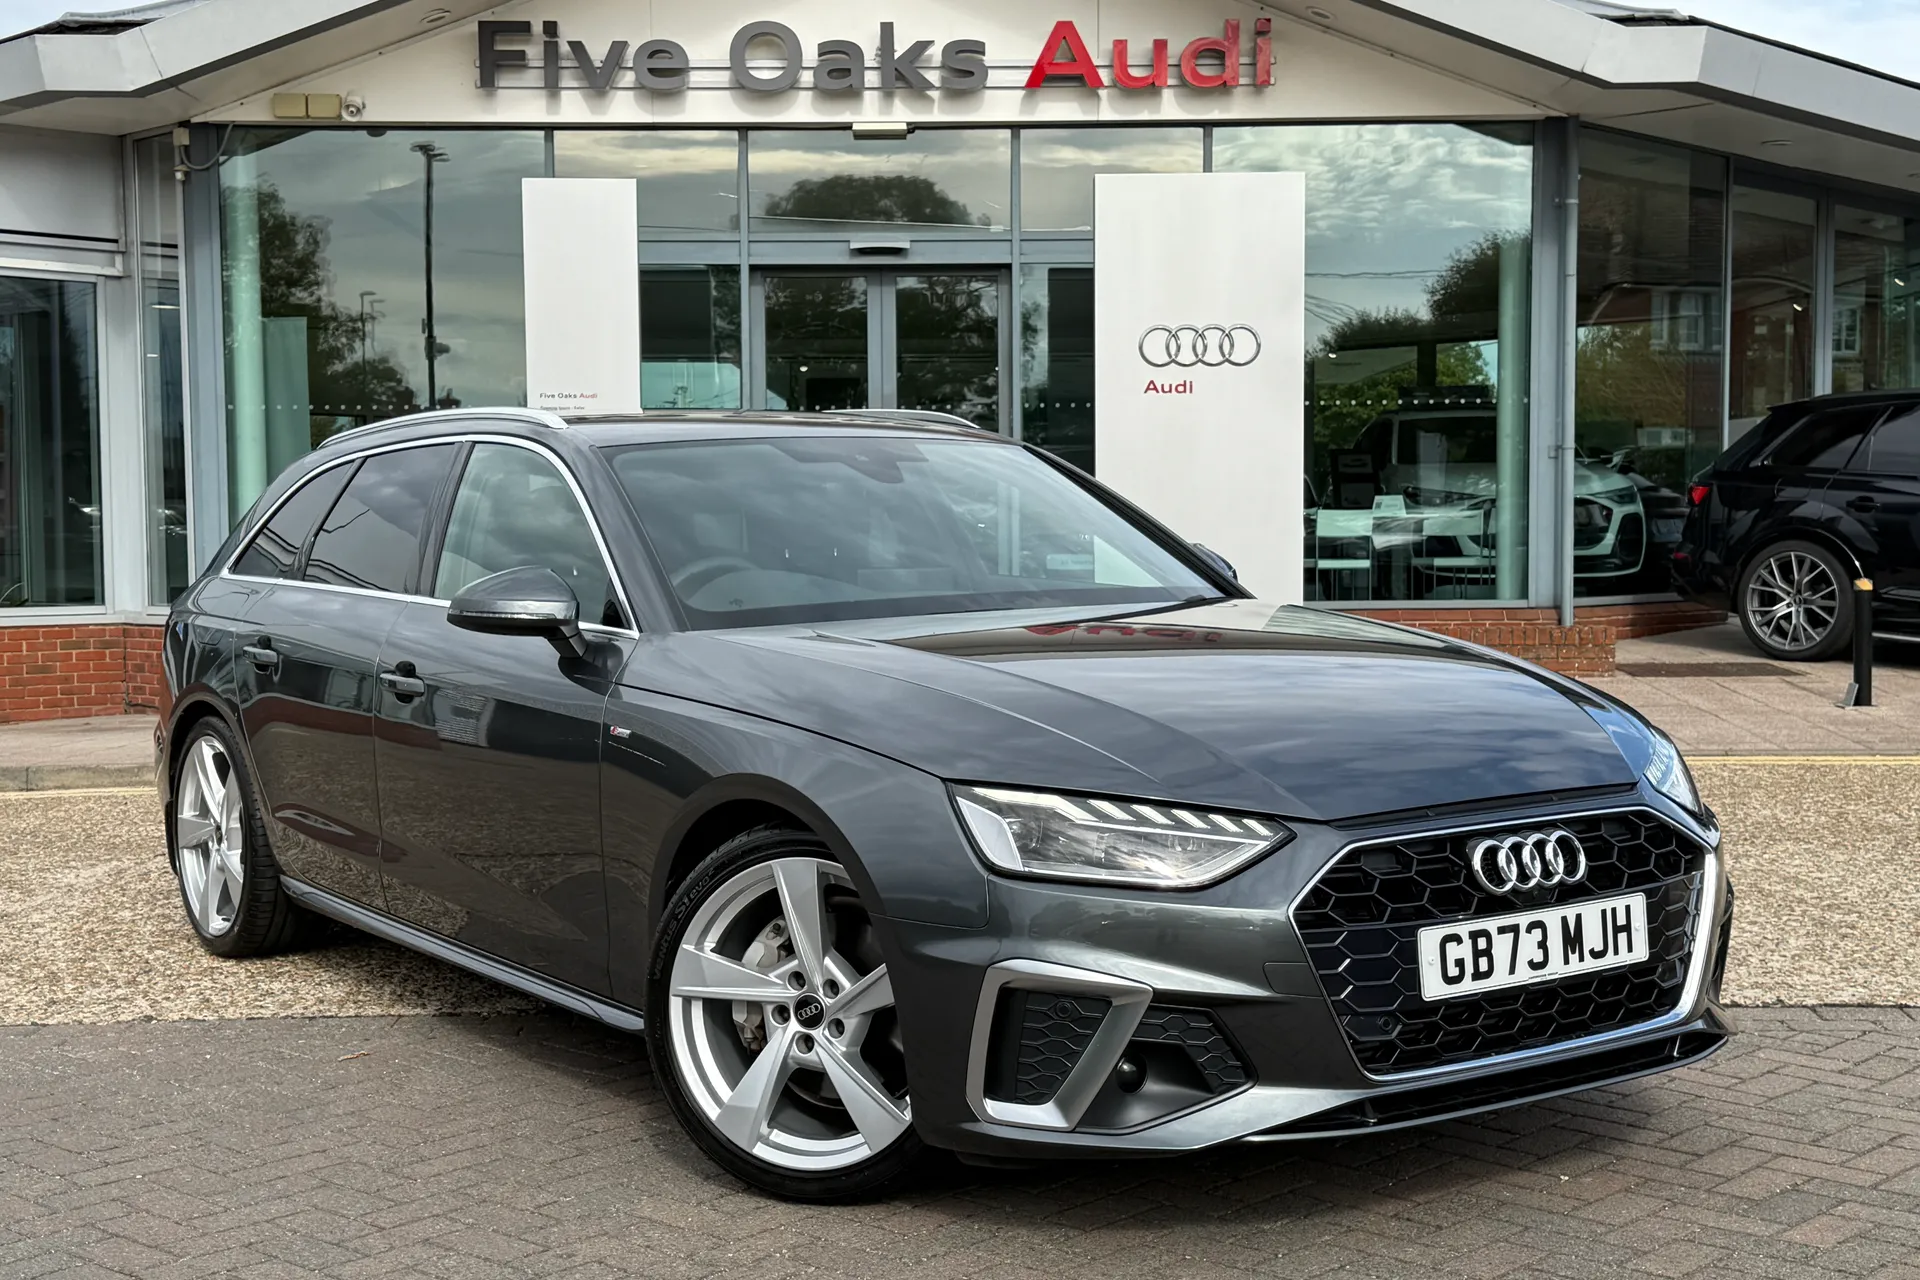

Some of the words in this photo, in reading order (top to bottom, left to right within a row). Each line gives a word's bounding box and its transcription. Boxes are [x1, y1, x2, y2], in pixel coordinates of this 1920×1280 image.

[477, 20, 690, 91] Five
[729, 20, 989, 91] Oaks
[1024, 18, 1272, 89] Audi
[1143, 379, 1194, 395] Audi
[1439, 919, 1550, 986] GB73
[1560, 904, 1634, 966] MJH
